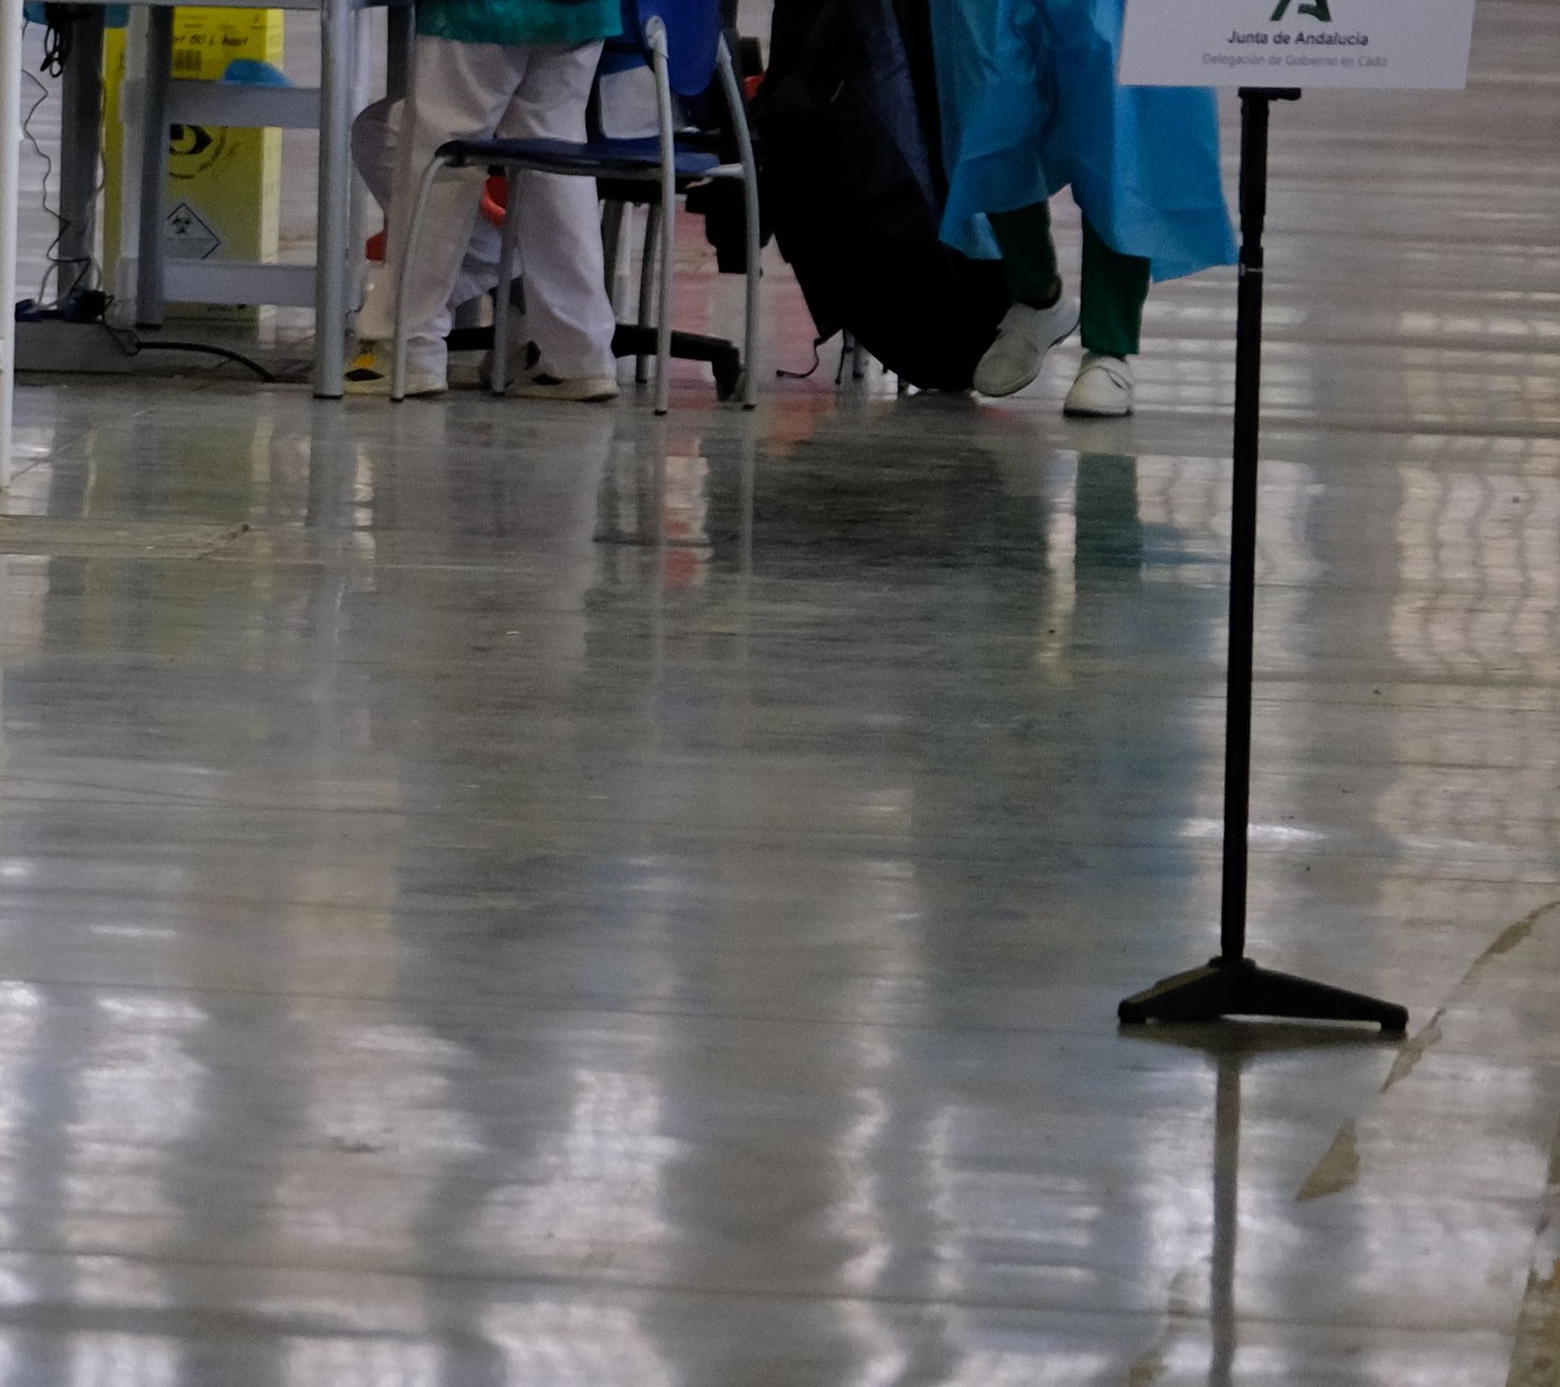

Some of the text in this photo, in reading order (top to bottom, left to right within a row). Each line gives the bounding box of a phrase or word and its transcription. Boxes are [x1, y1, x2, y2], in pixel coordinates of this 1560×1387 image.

[1226, 30, 1269, 46] Junta
[1273, 31, 1291, 45] de
[1202, 52, 1266, 68] Delegación
[1268, 53, 1282, 66] de
